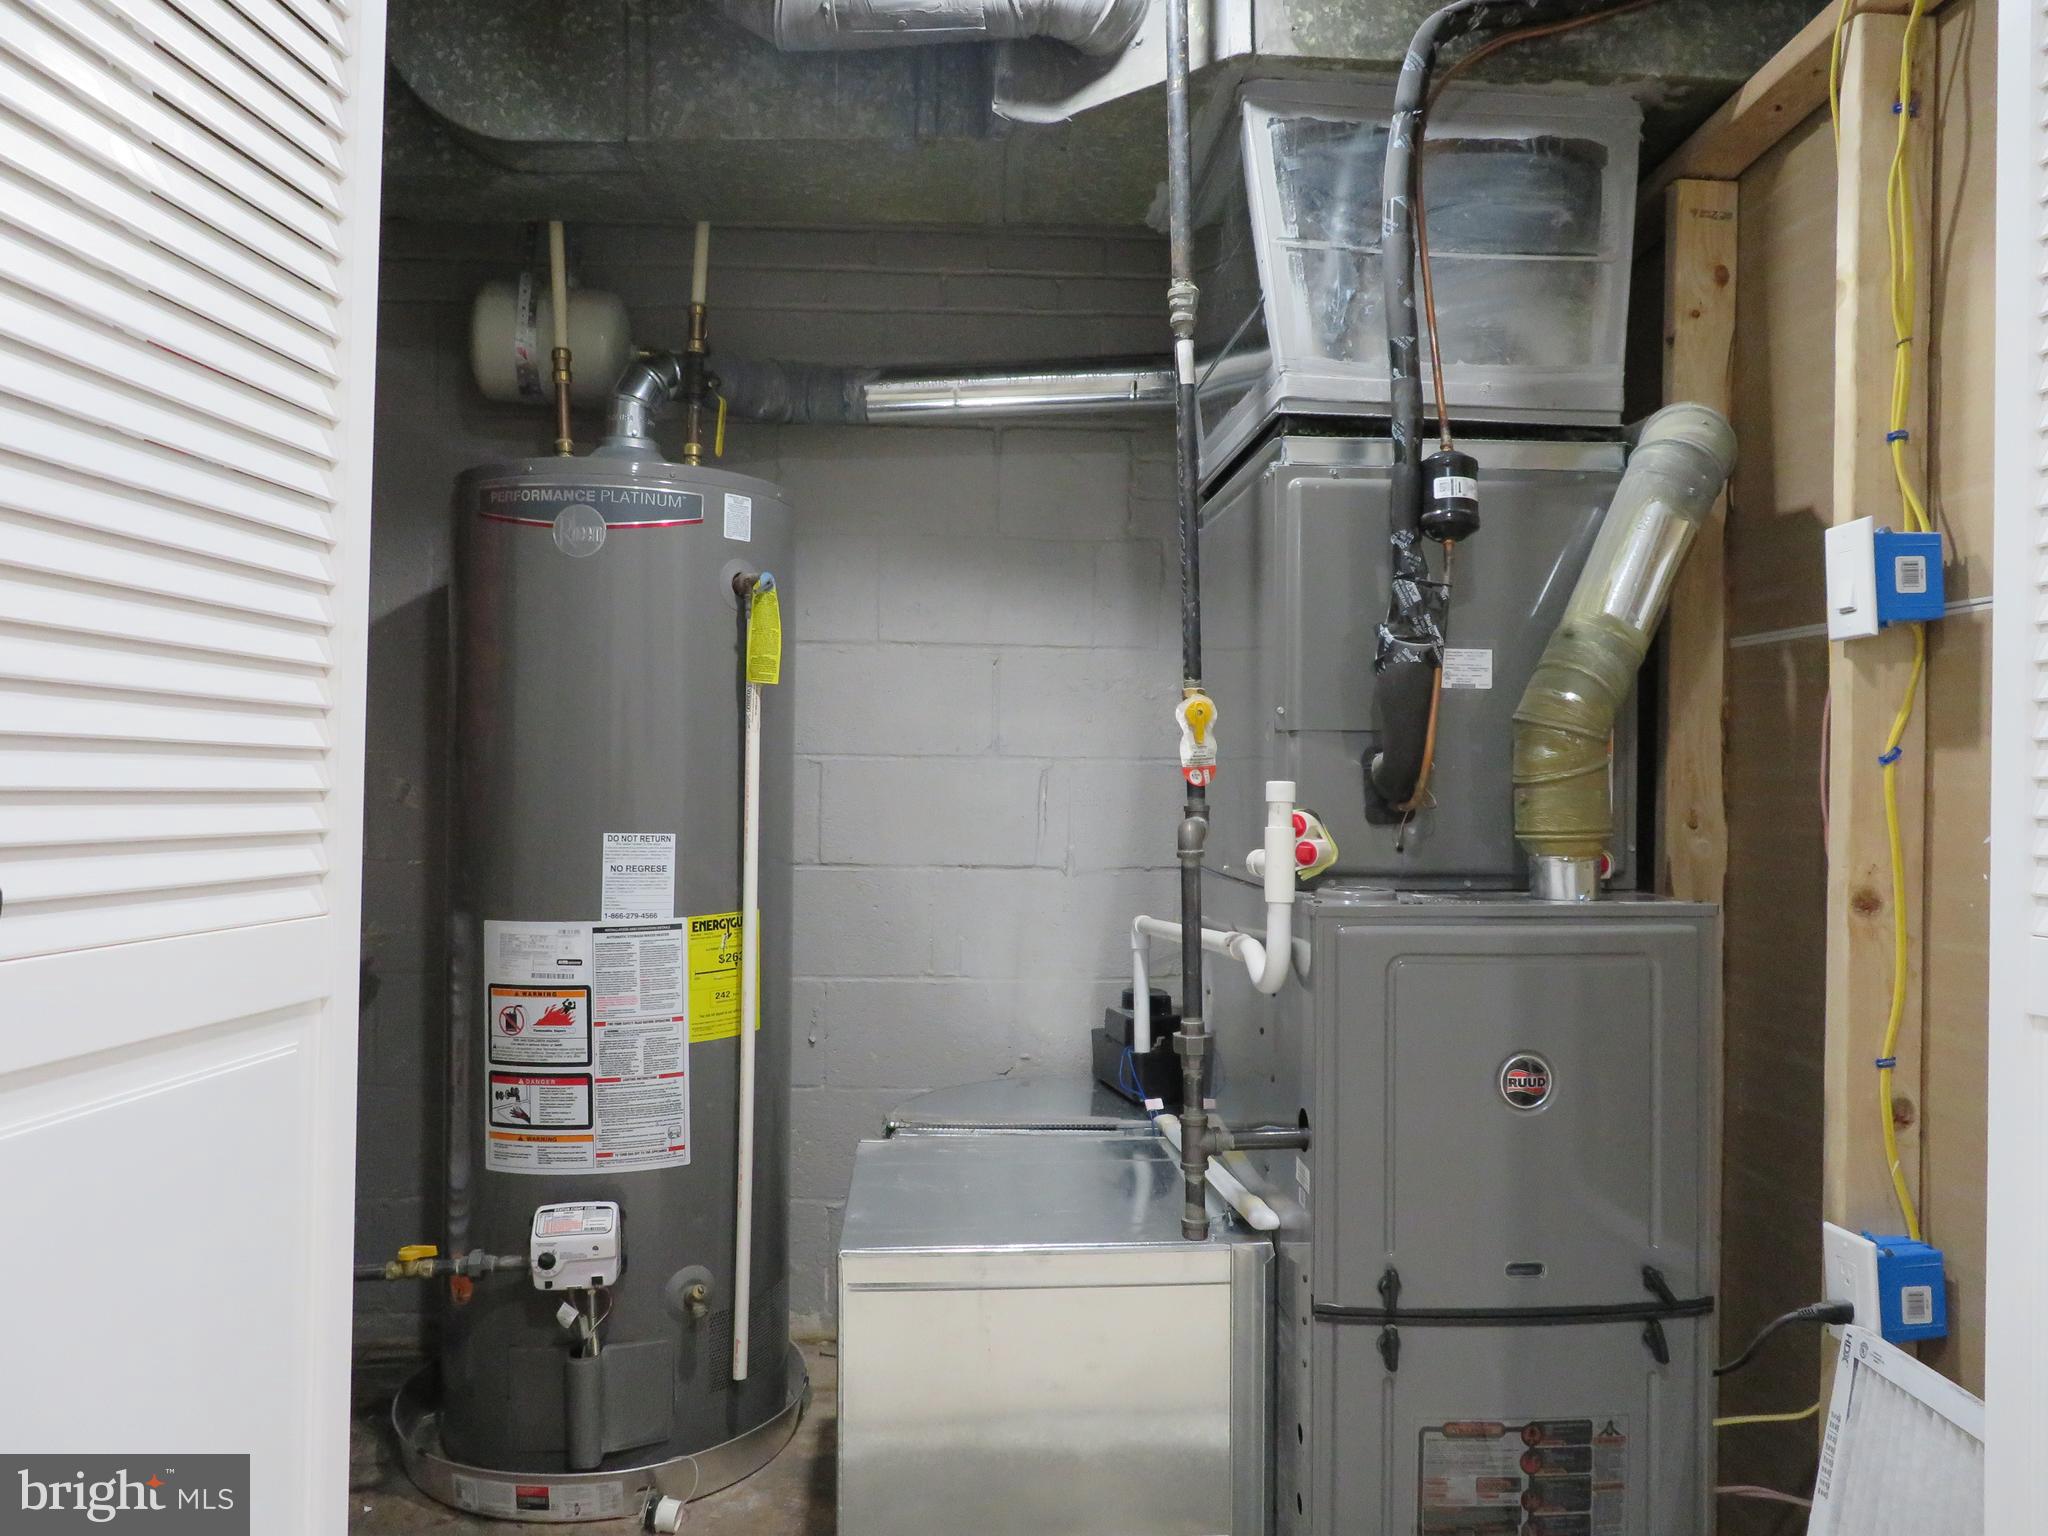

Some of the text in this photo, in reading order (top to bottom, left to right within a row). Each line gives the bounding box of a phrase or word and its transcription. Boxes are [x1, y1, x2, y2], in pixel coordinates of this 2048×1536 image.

[491, 490, 682, 508] PERFORMANCE PLATINUM
[607, 834, 672, 843] DO NOT RETURN
[610, 865, 668, 873] NO REGRESE
[604, 912, 658, 920] 1-866-279-4566
[715, 990, 731, 1000] 242
[1508, 1077, 1546, 1087] RUUD
